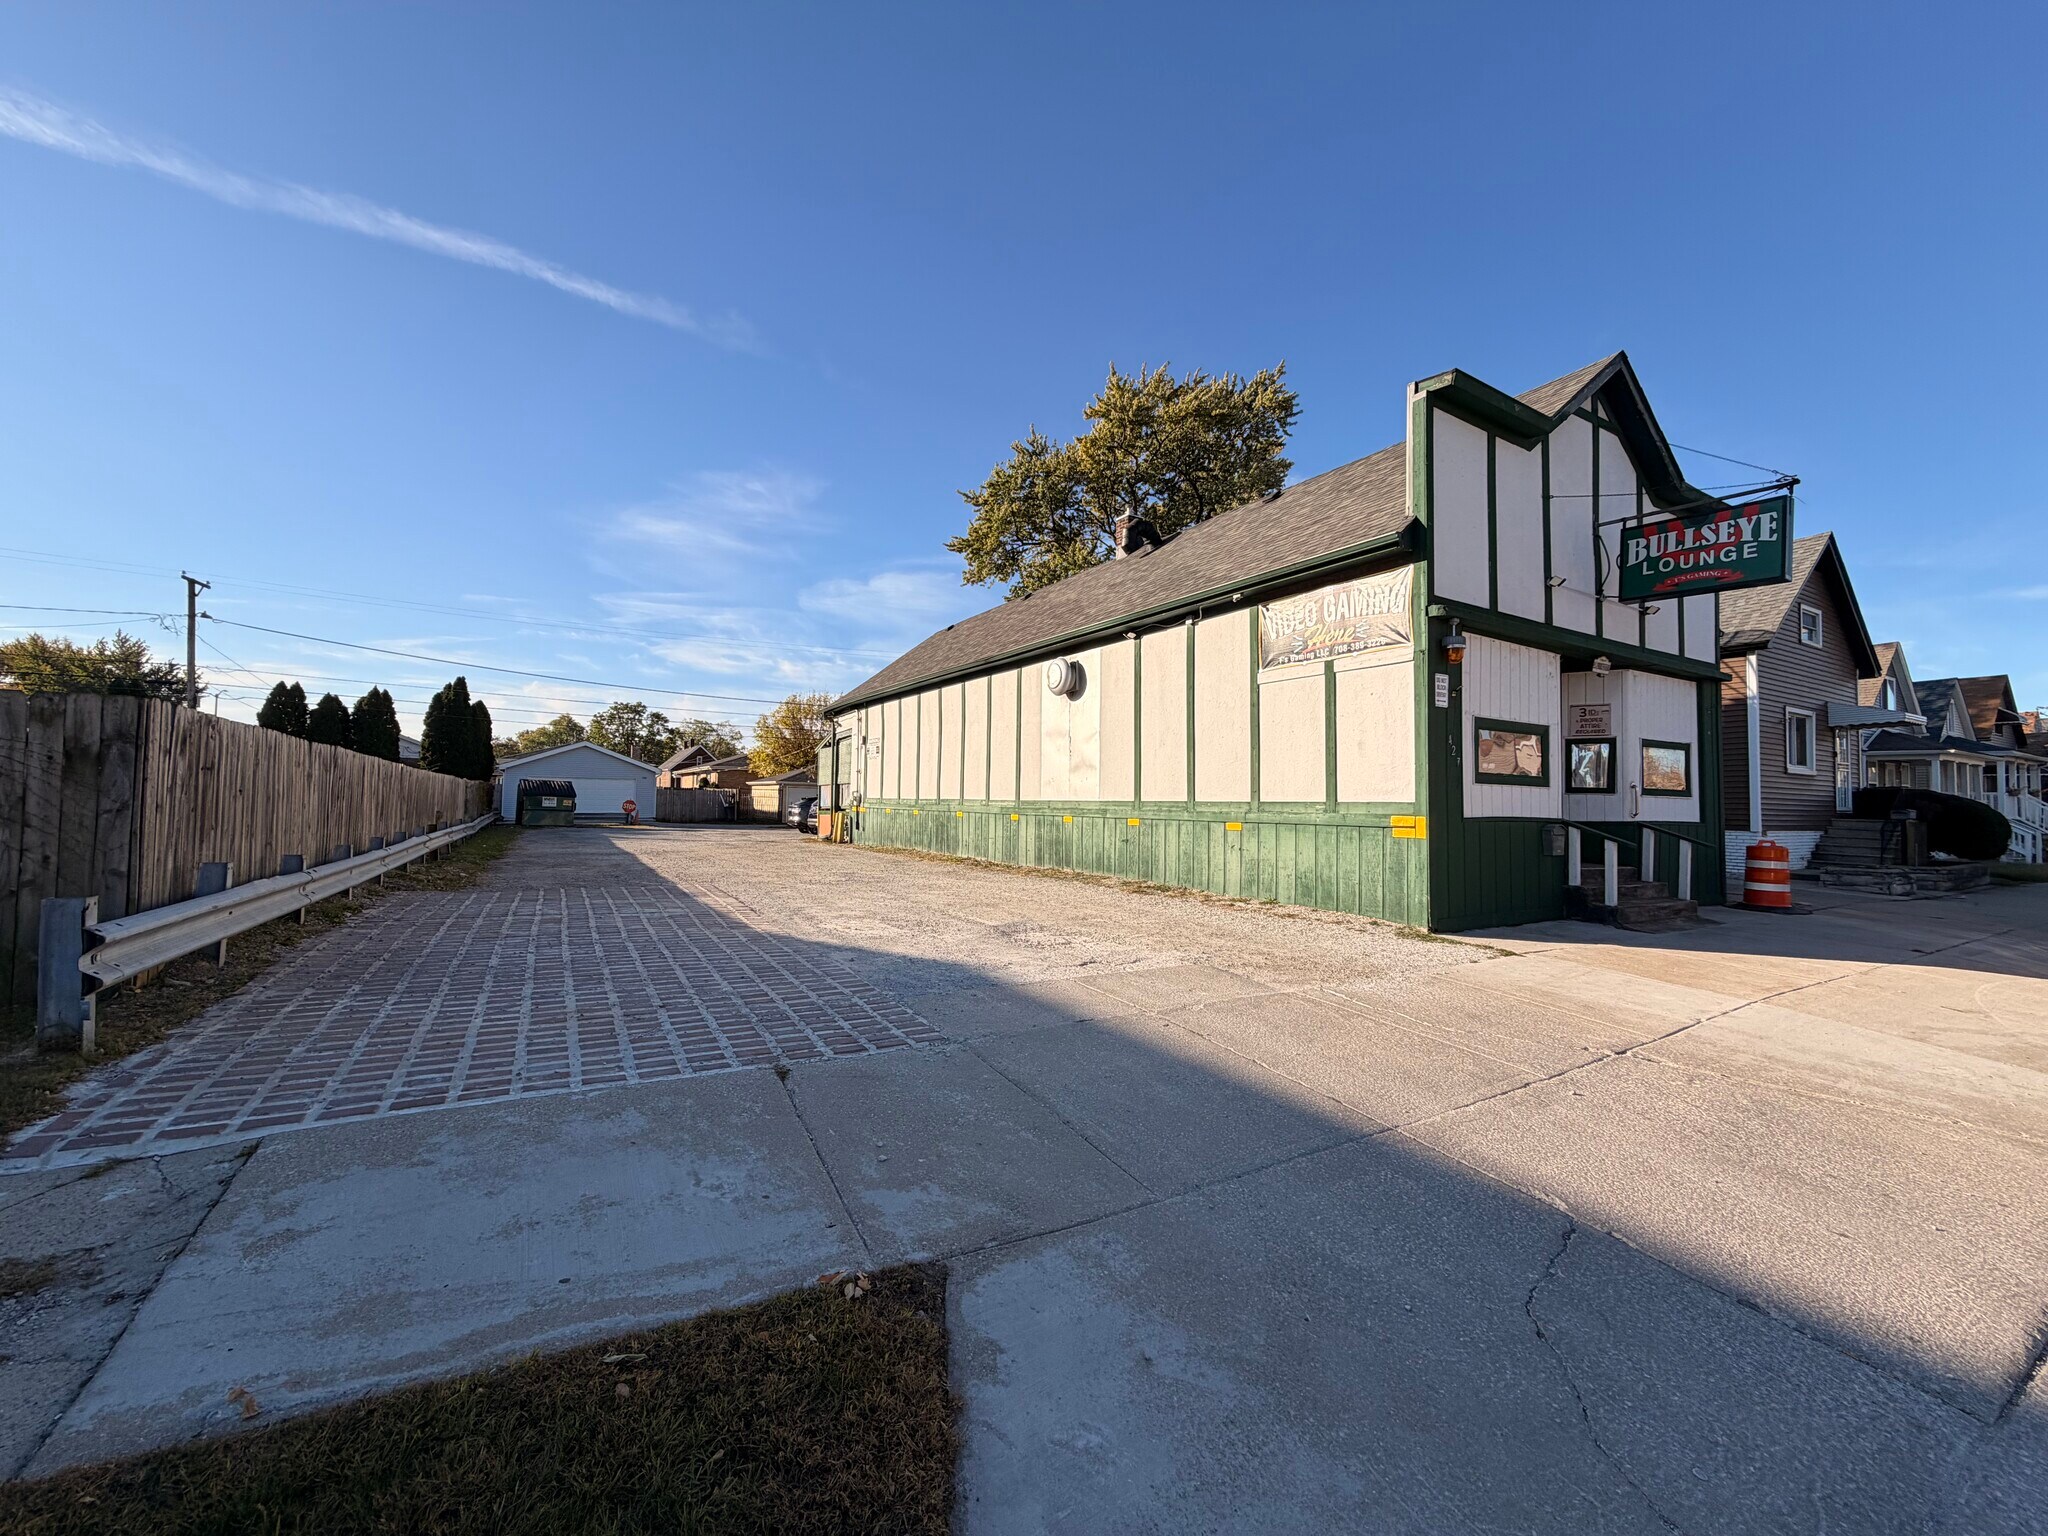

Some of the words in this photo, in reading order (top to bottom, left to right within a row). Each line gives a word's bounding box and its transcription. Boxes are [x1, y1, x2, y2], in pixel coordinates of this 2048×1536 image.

[1627, 511, 1778, 567] BULLSEYE
[1642, 542, 1758, 575] LOUNGE
[1687, 571, 1721, 579] GAMING
[1263, 603, 1317, 641] VIDEO
[1323, 584, 1406, 623] GAMING
[1305, 624, 1356, 647] Here
[1290, 651, 1315, 662] Gaming
[1316, 648, 1330, 658] LLC
[1578, 707, 1587, 718] 3
